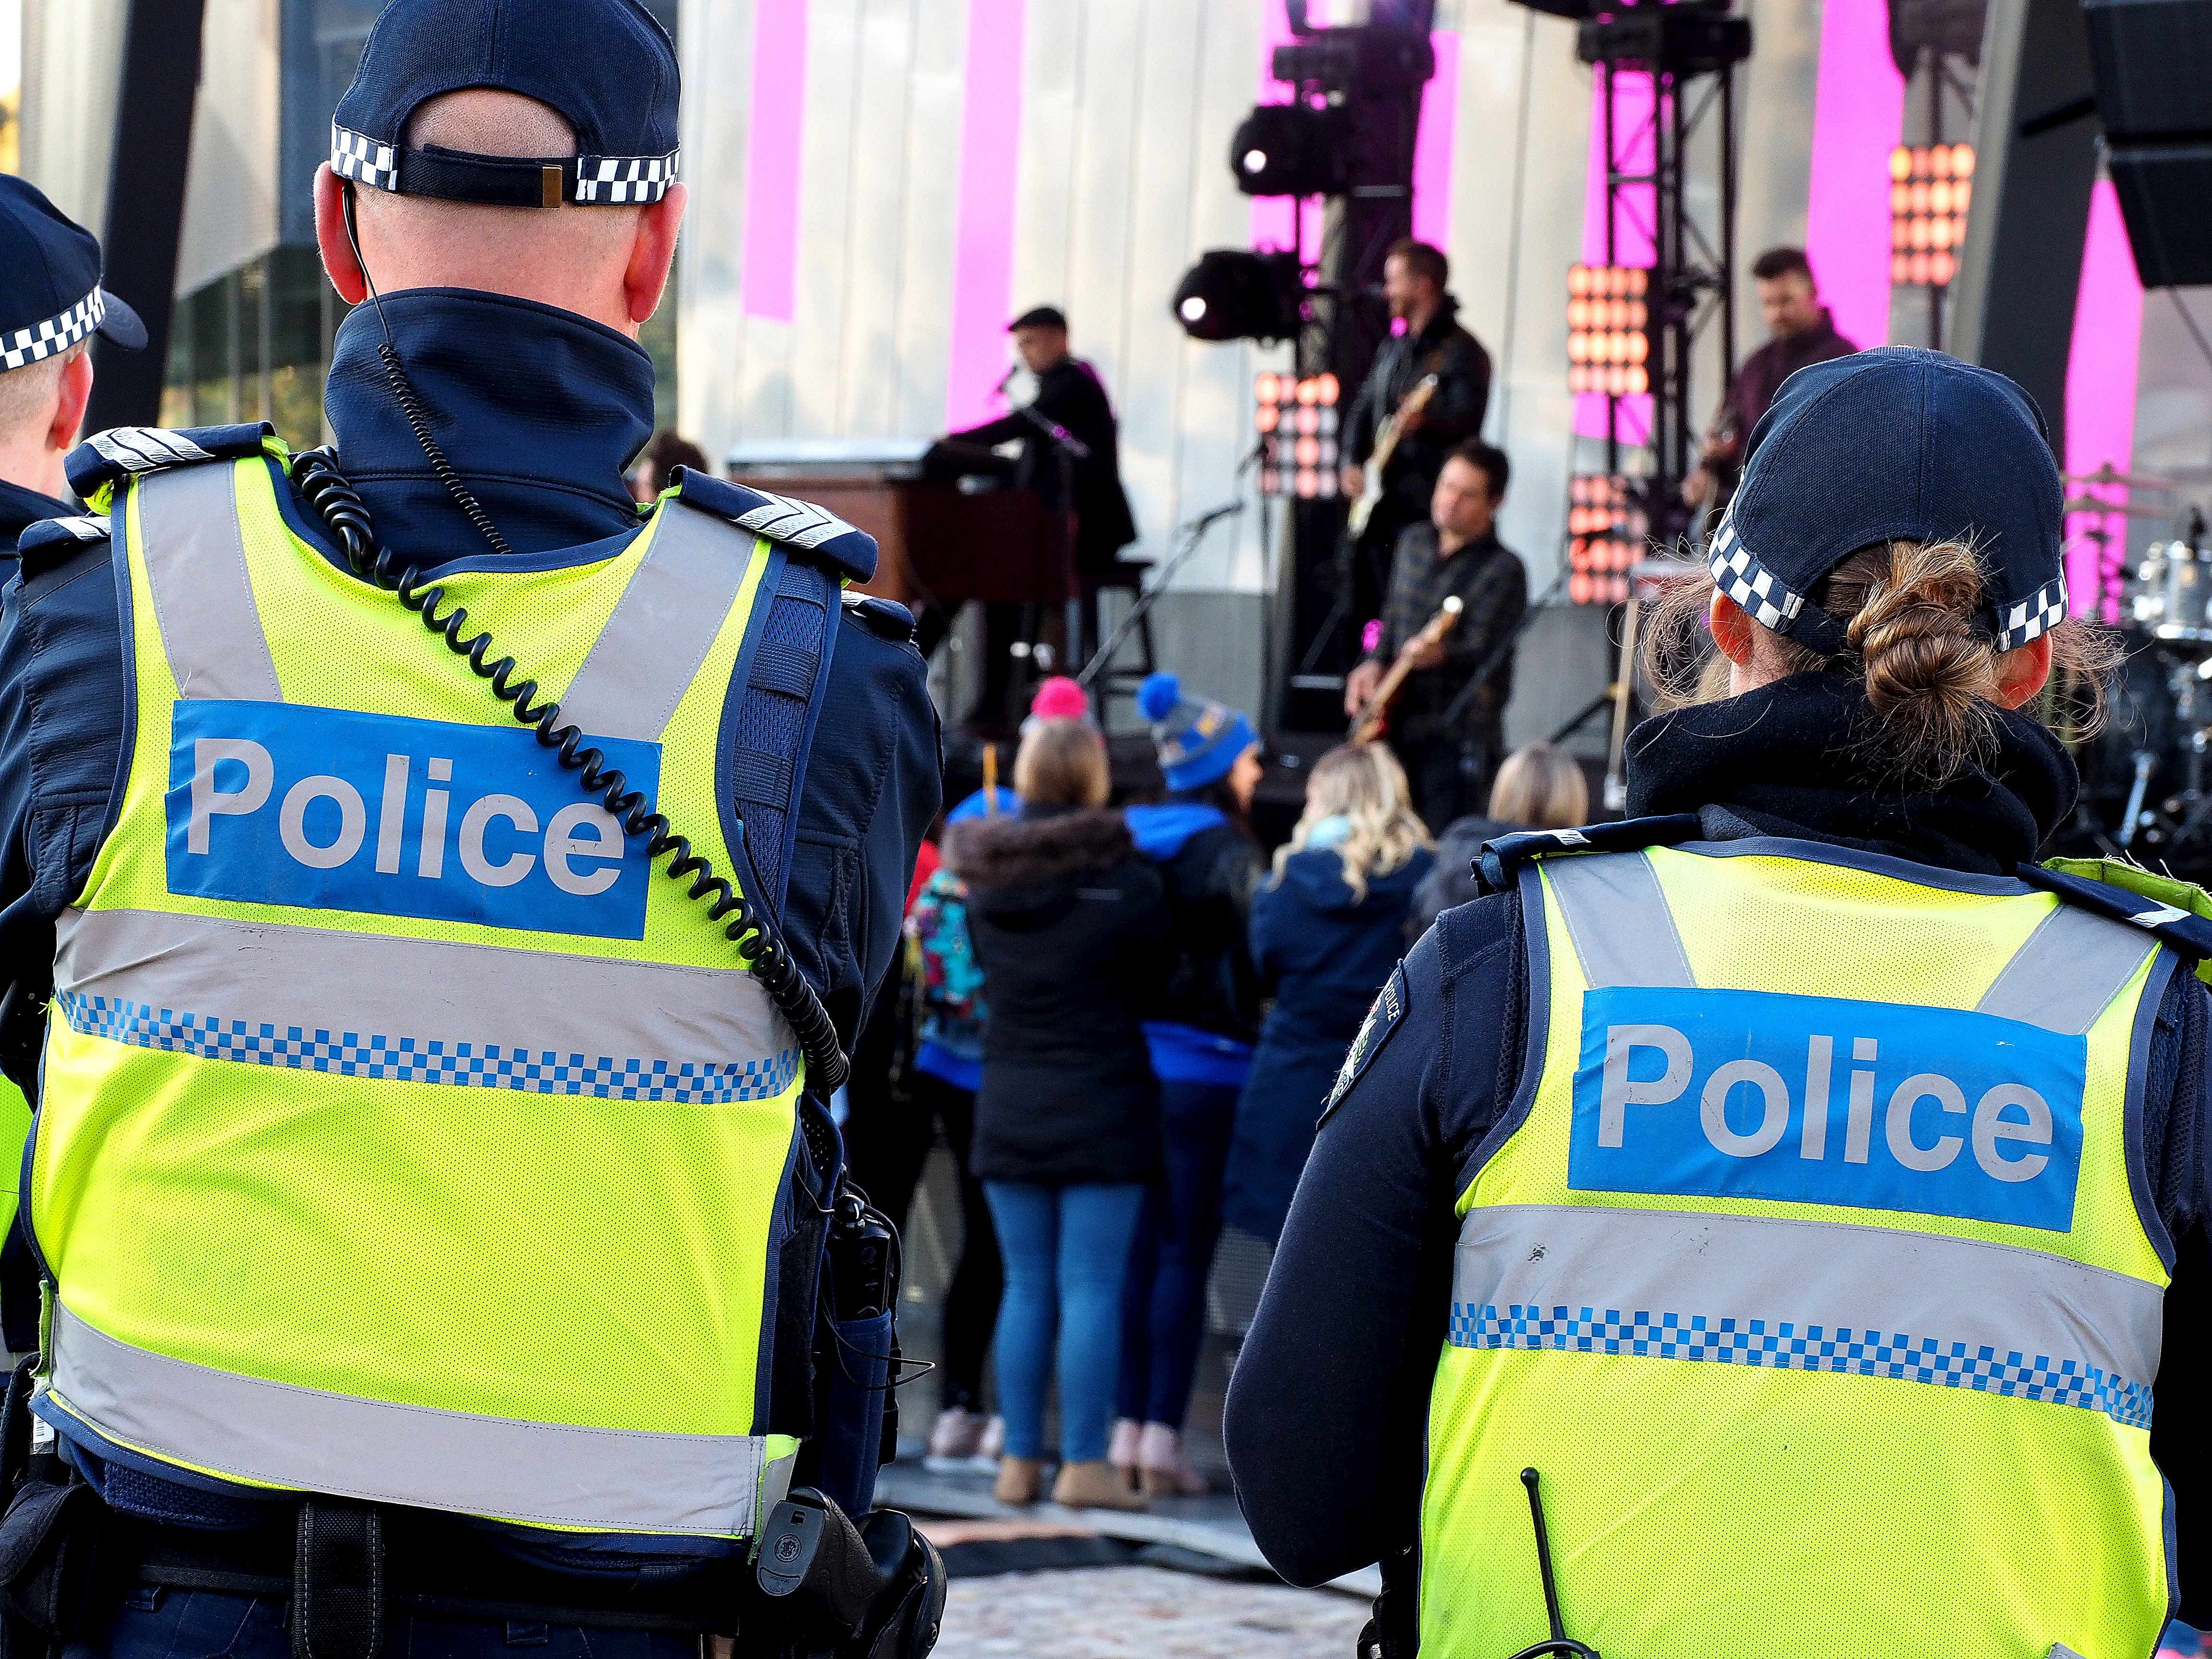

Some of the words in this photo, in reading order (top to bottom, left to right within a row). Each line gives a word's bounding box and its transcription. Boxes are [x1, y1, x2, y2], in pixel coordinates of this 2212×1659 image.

[188, 738, 625, 895] Police
[1384, 983, 1400, 1021] POLICE
[1597, 1024, 2054, 1182] Police
